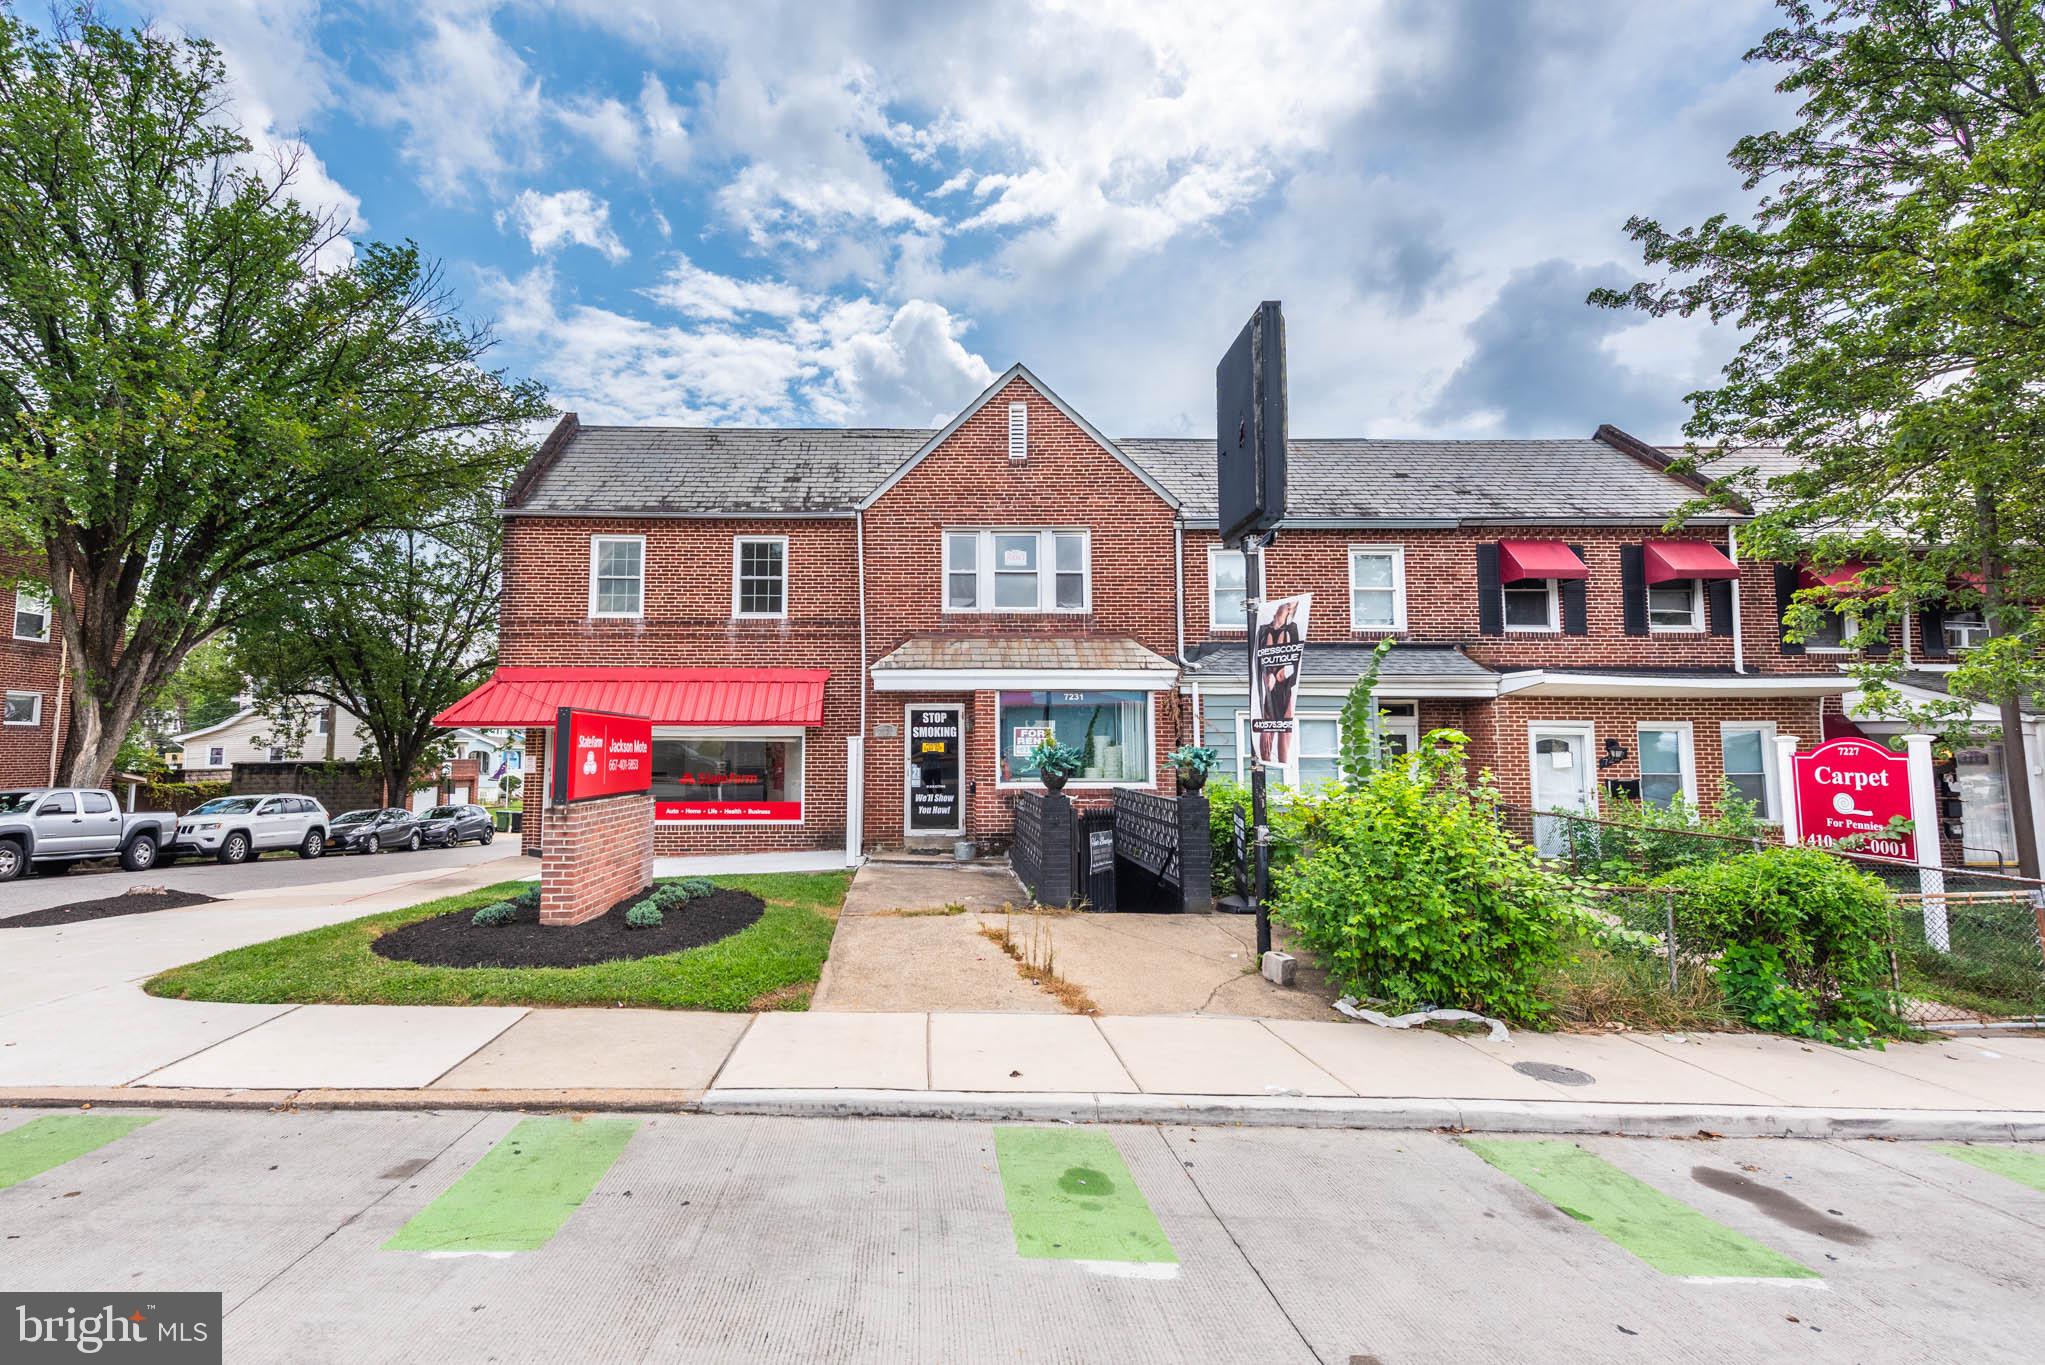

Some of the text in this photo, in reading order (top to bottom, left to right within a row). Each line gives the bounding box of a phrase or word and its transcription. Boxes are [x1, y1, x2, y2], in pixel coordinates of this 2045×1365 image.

[1063, 693, 1084, 701] 7231
[922, 712, 947, 723] STOP
[912, 726, 957, 737] SMOKING
[1020, 729, 1045, 737] FOR
[609, 738, 648, 753] Jackson Mote
[1838, 747, 1859, 756] 7227
[1814, 766, 1889, 791] Carpet
[915, 793, 955, 802] We'll Show
[918, 805, 951, 815] You How!
[1826, 817, 1884, 831] For Pennies
